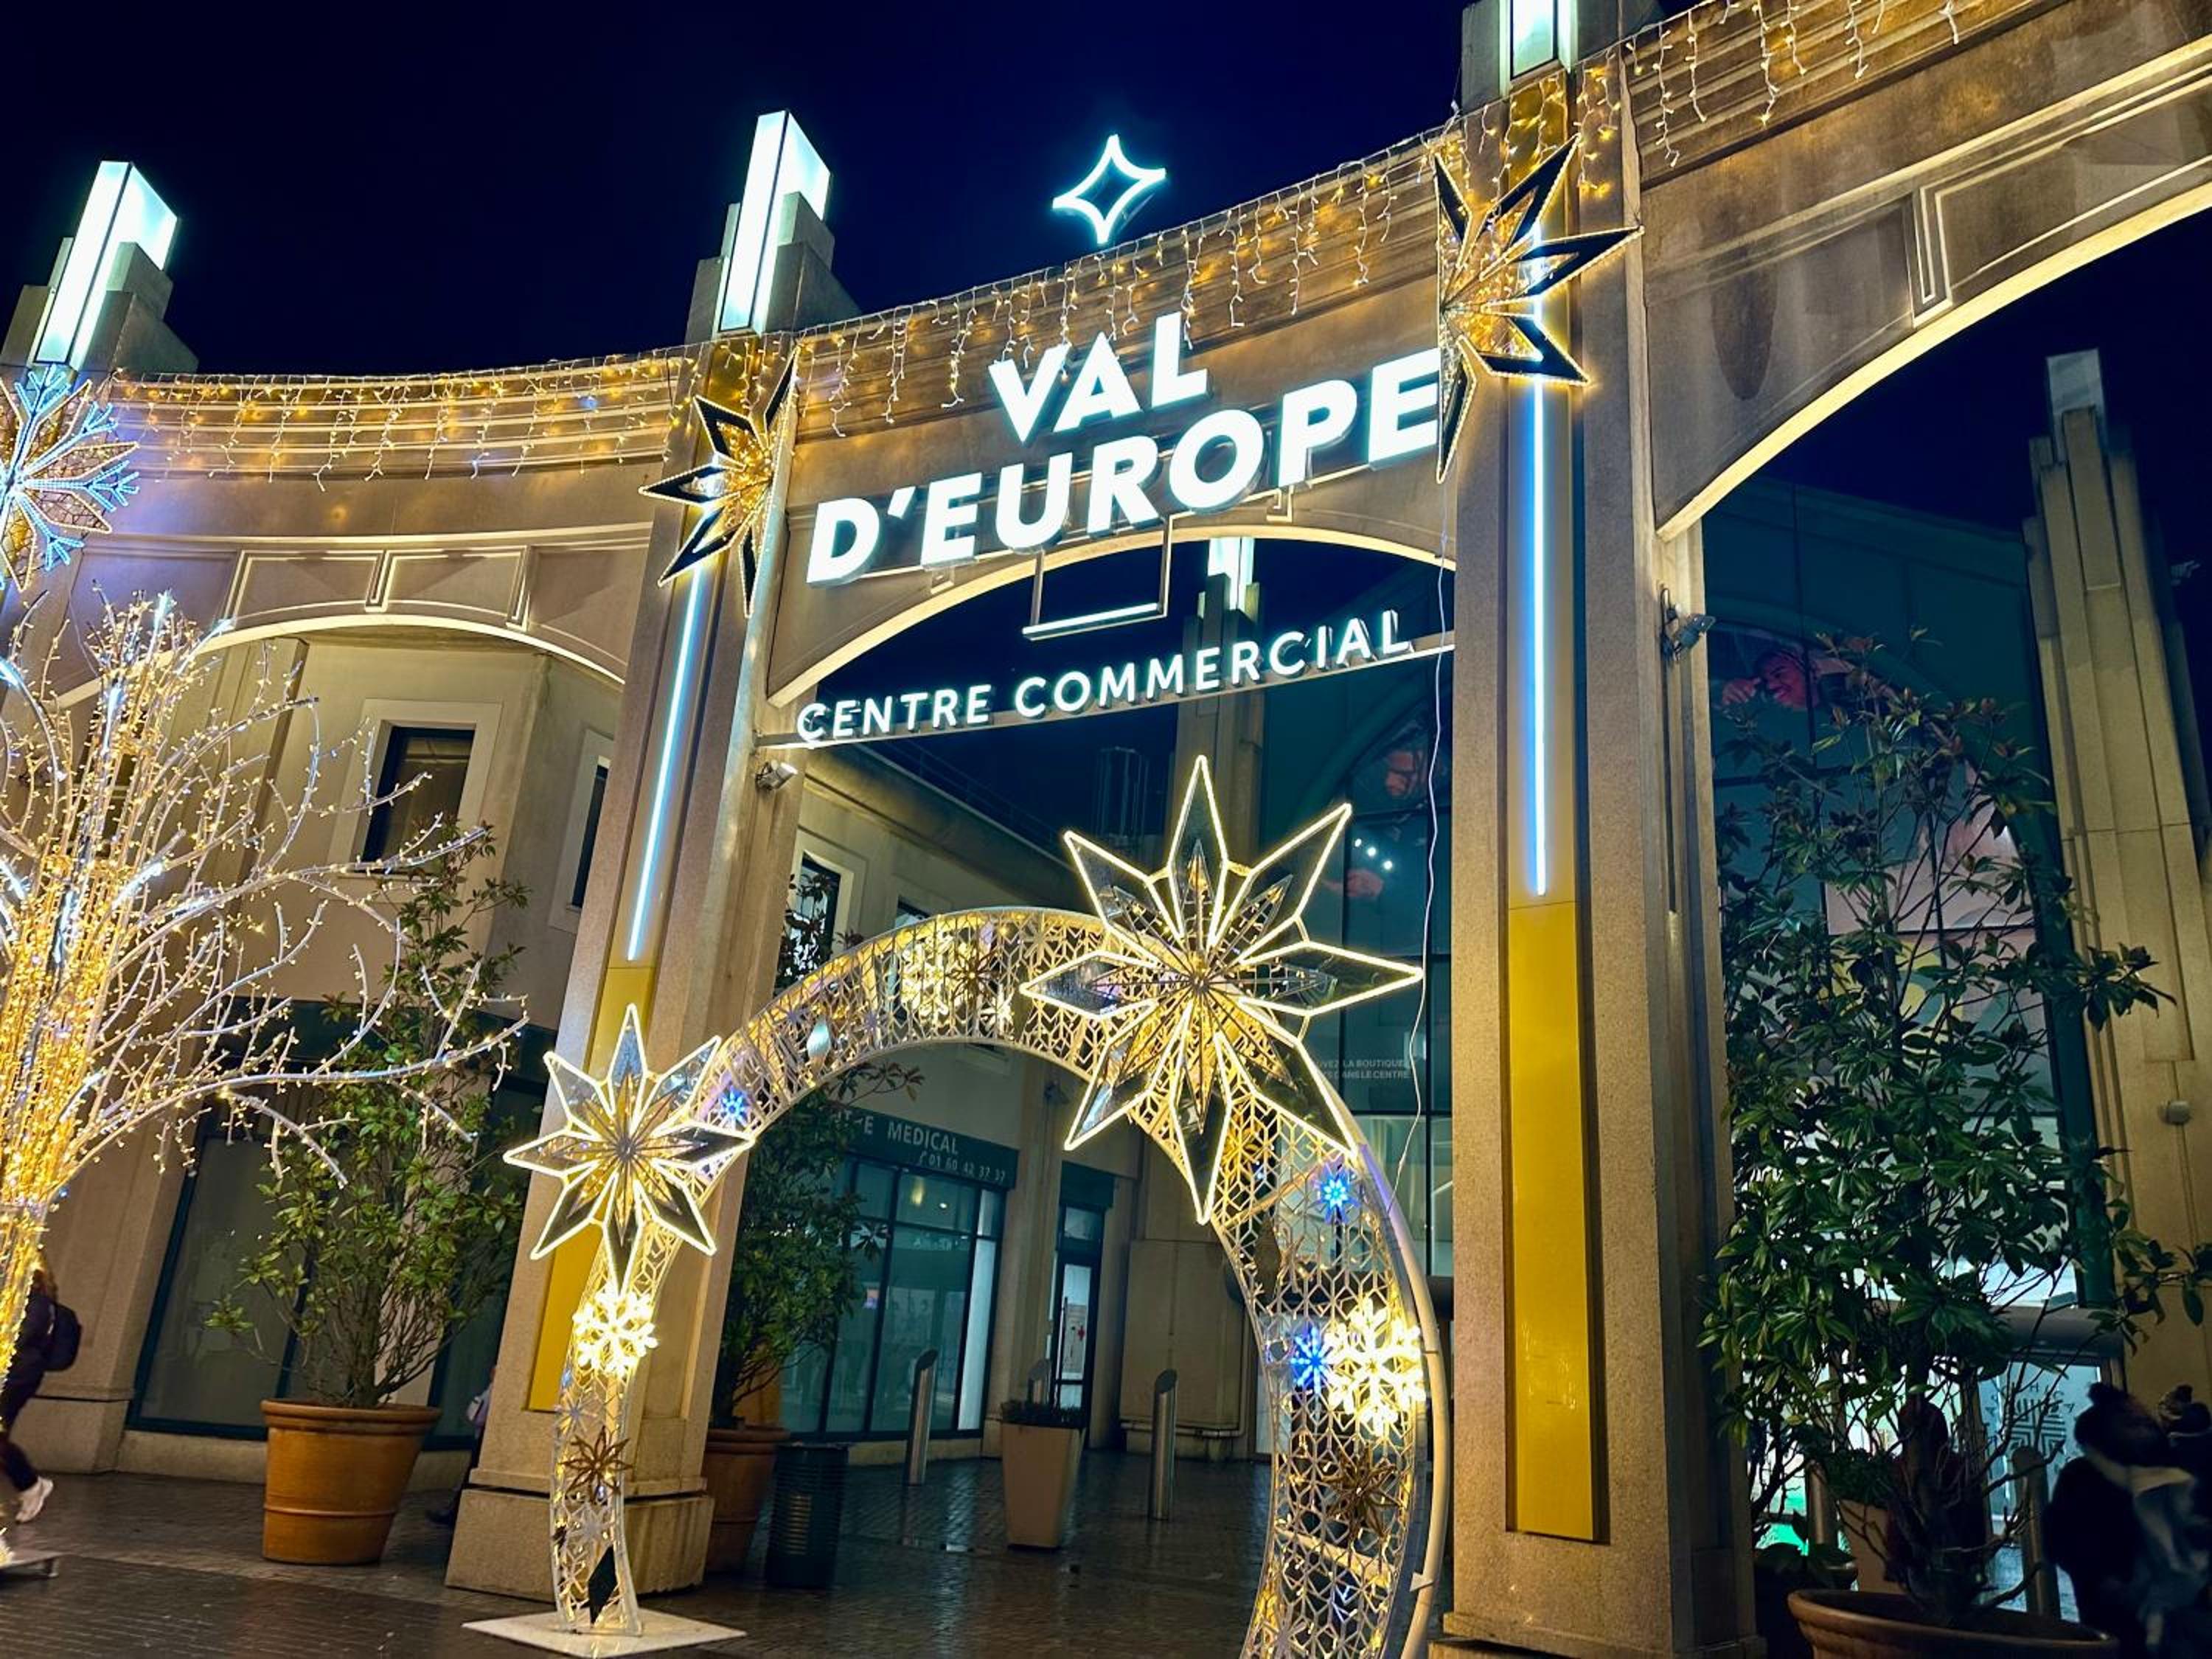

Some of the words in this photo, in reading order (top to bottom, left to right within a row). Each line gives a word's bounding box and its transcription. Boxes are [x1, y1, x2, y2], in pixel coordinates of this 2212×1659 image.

[988, 313, 1210, 442] VAL
[806, 347, 1441, 585] D'EUROPE
[796, 684, 992, 742] CENTRE
[1015, 609, 1413, 718] COMMERCIAL
[887, 1121, 959, 1155] MEDICAL
